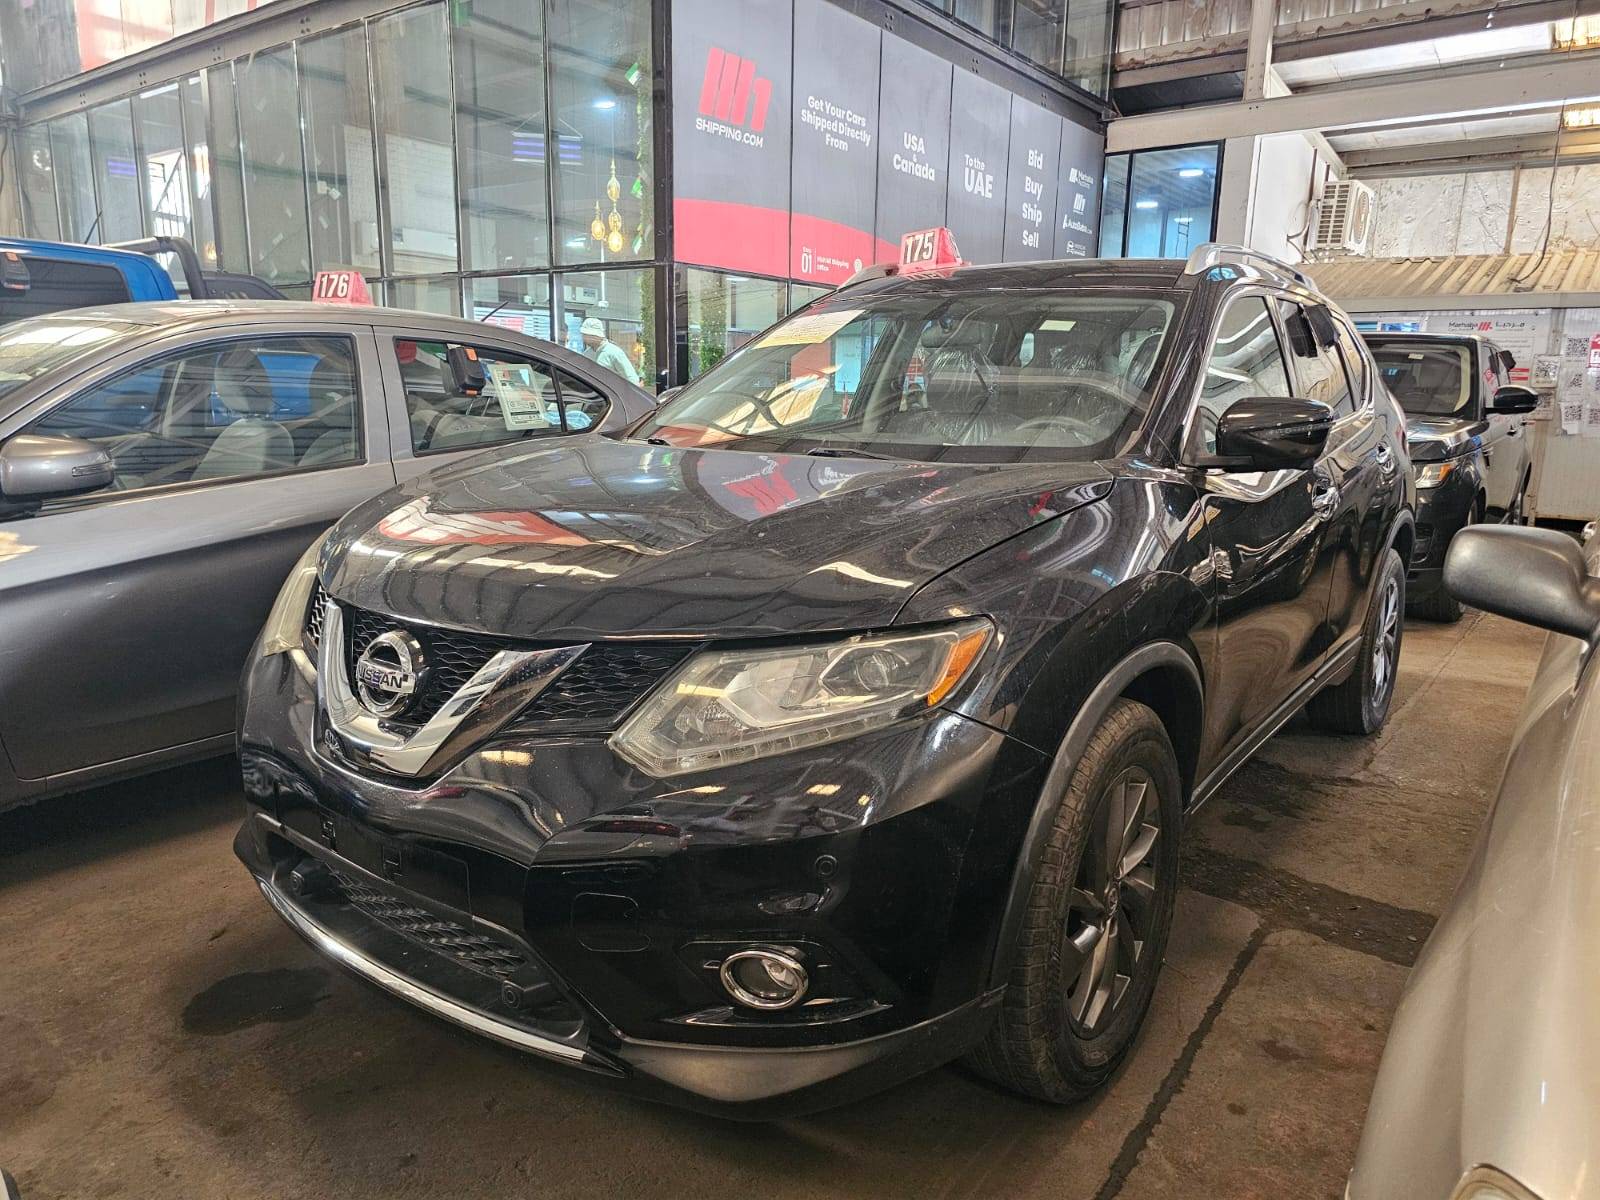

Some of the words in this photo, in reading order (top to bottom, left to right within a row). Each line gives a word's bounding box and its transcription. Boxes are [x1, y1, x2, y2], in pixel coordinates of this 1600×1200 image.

[807, 96, 824, 112] Get
[825, 101, 846, 119] Your
[846, 109, 867, 127] Cars
[695, 117, 764, 148] SHIPPING.COM
[801, 108, 838, 132] Shipped
[838, 122, 871, 147] Directly
[825, 133, 849, 152] From
[903, 131, 926, 154] USA
[893, 153, 936, 181] Canada
[964, 154, 974, 167] To
[974, 157, 985, 171] the
[1027, 149, 1043, 170] Bid
[964, 167, 993, 199] UAE
[1024, 175, 1043, 201] Buy
[1022, 202, 1042, 228] Ship
[905, 231, 935, 265] 175
[1022, 229, 1039, 249] Sell
[801, 253, 812, 273] 01
[320, 273, 349, 298] 176
